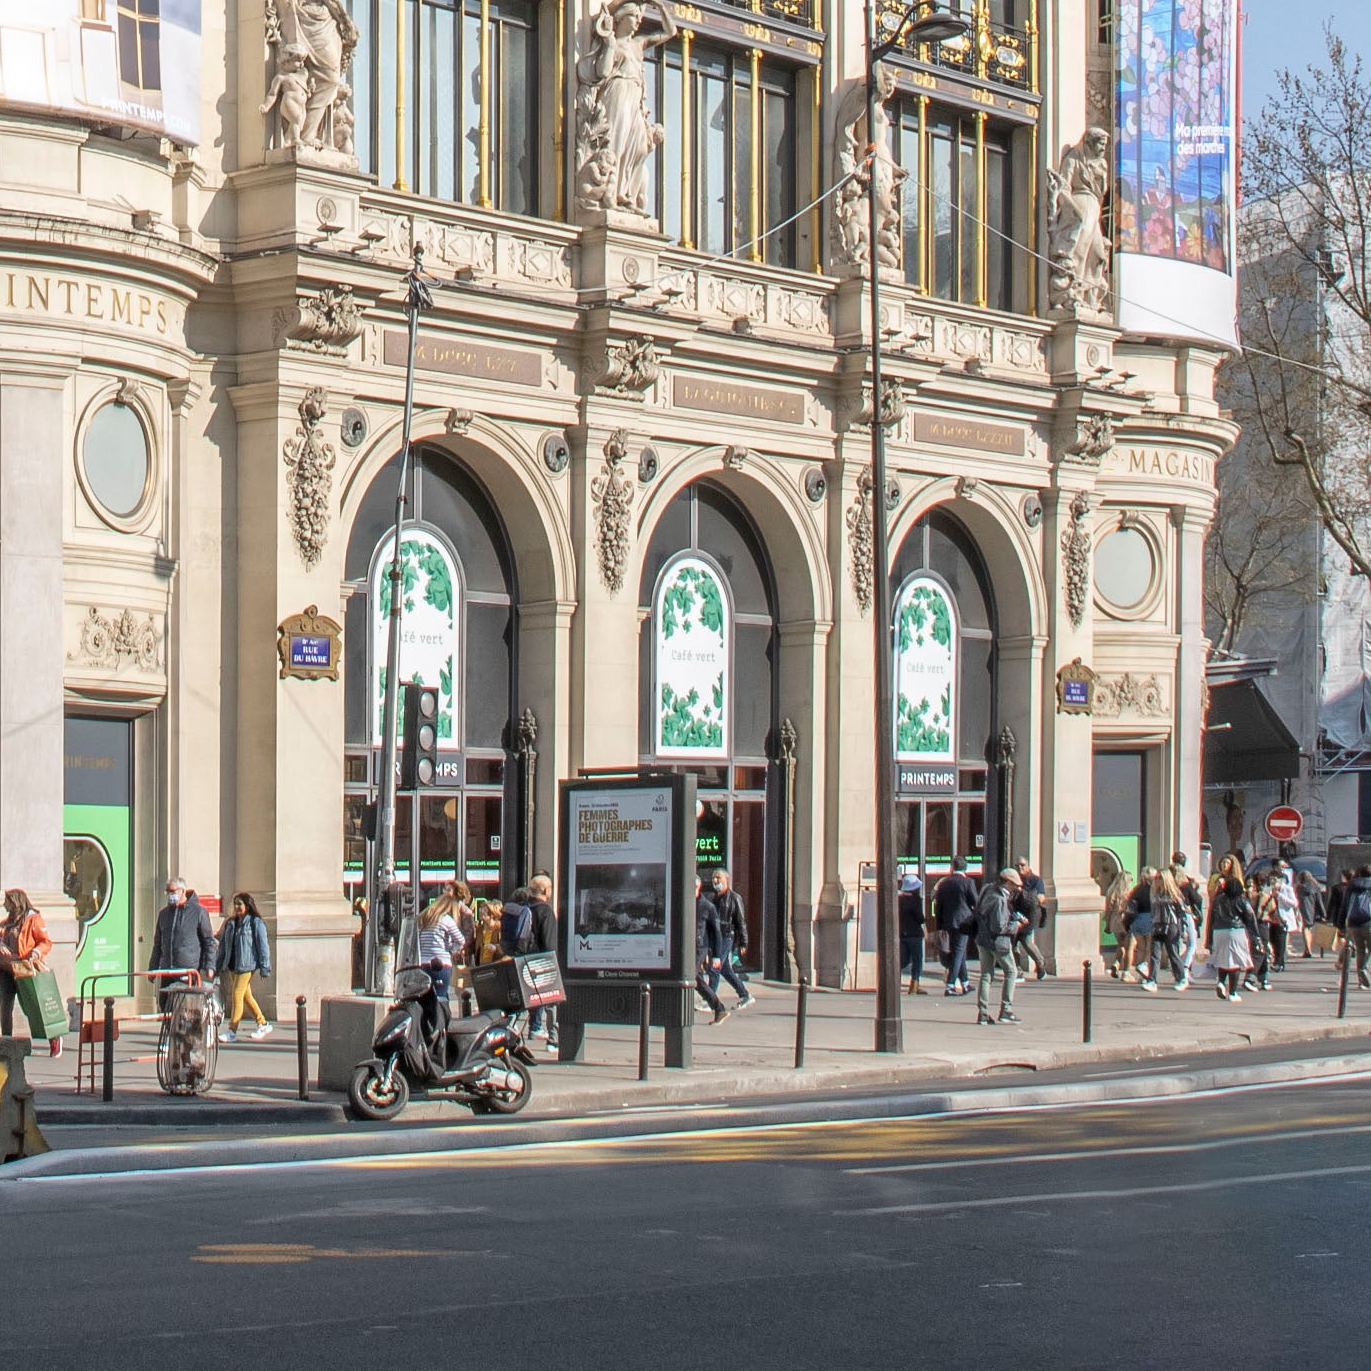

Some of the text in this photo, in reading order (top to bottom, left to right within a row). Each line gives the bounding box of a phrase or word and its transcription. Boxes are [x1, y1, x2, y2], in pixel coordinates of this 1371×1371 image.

[1128, 448, 1214, 485] MAGASIN
[900, 771, 955, 786] PRINTEMPS
[579, 809, 618, 821] FEMMES
[579, 819, 653, 832] PHOTOGRAPHES
[579, 831, 630, 844] DE GUERRE
